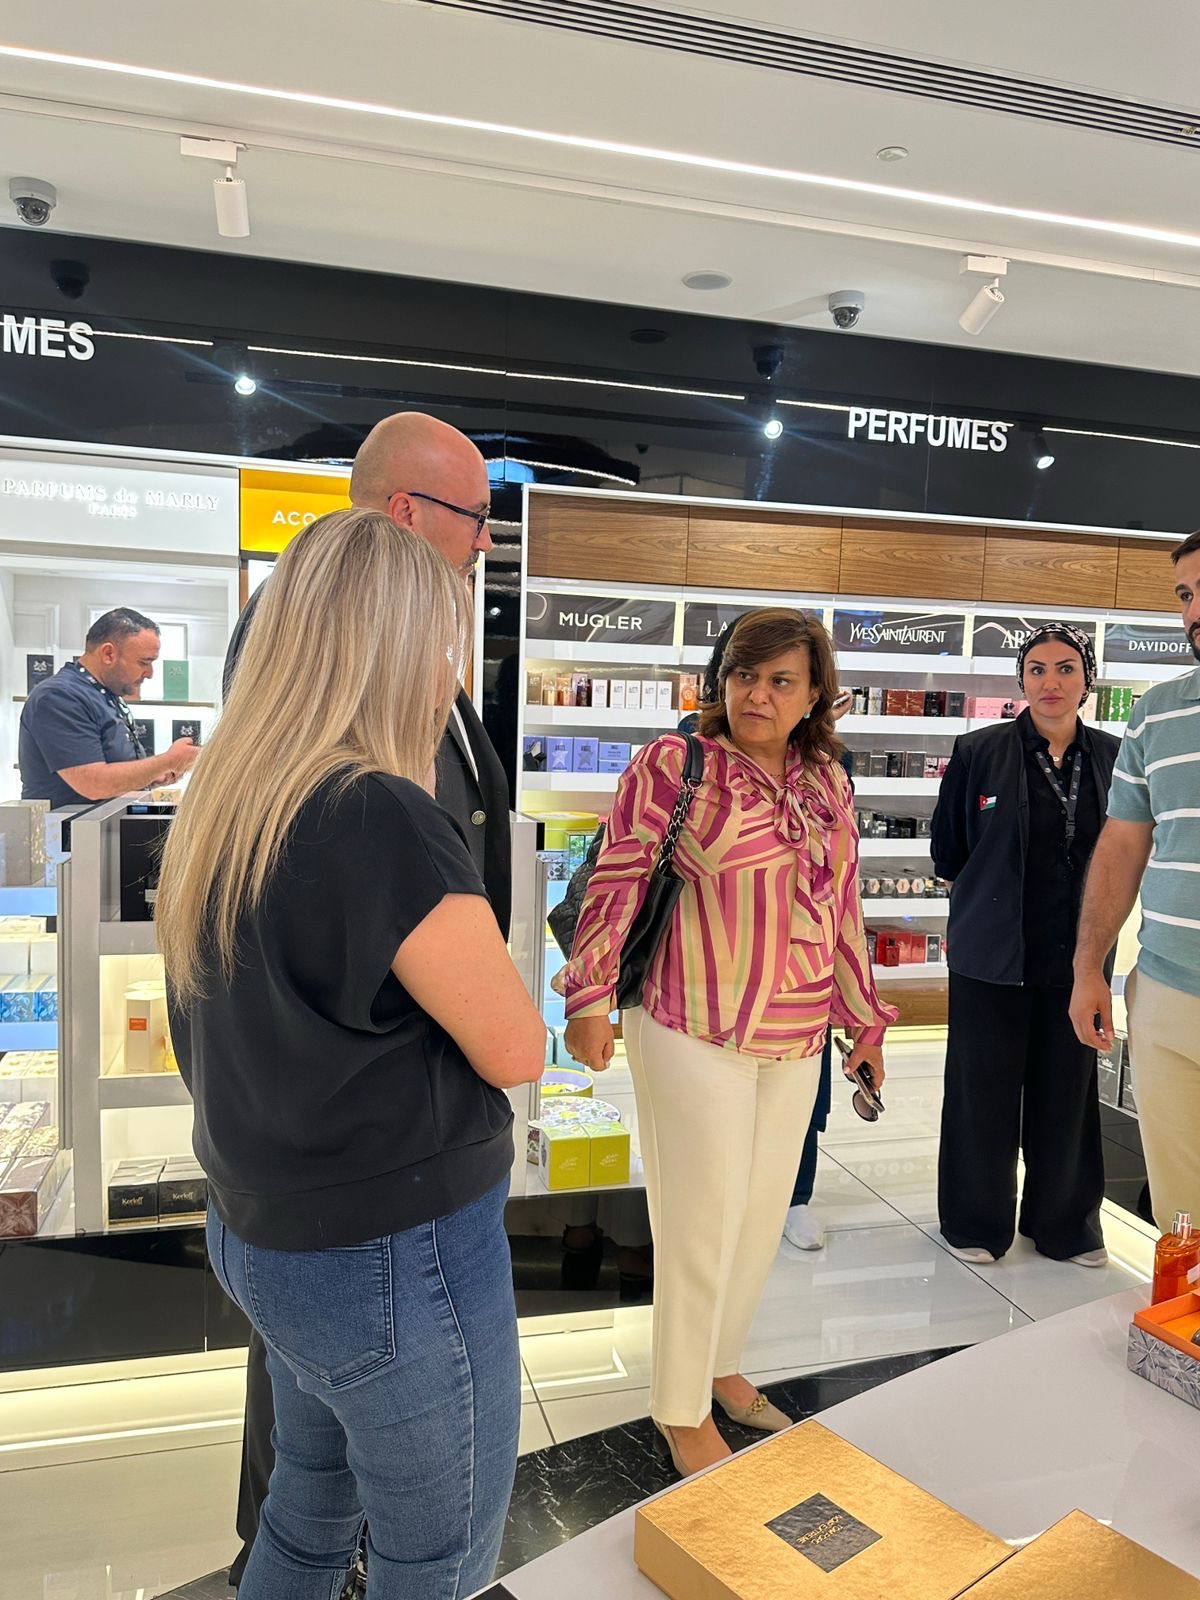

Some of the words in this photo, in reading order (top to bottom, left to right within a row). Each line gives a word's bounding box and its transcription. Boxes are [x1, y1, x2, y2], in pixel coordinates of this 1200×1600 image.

[3, 314, 95, 361] MES
[848, 406, 1008, 452] PERFUMES
[3, 479, 106, 502] PARFUMS
[113, 488, 138, 504] de
[145, 489, 219, 512] MARLY
[559, 611, 643, 631] MUGLER
[1128, 640, 1192, 653] DAVIDOFF
